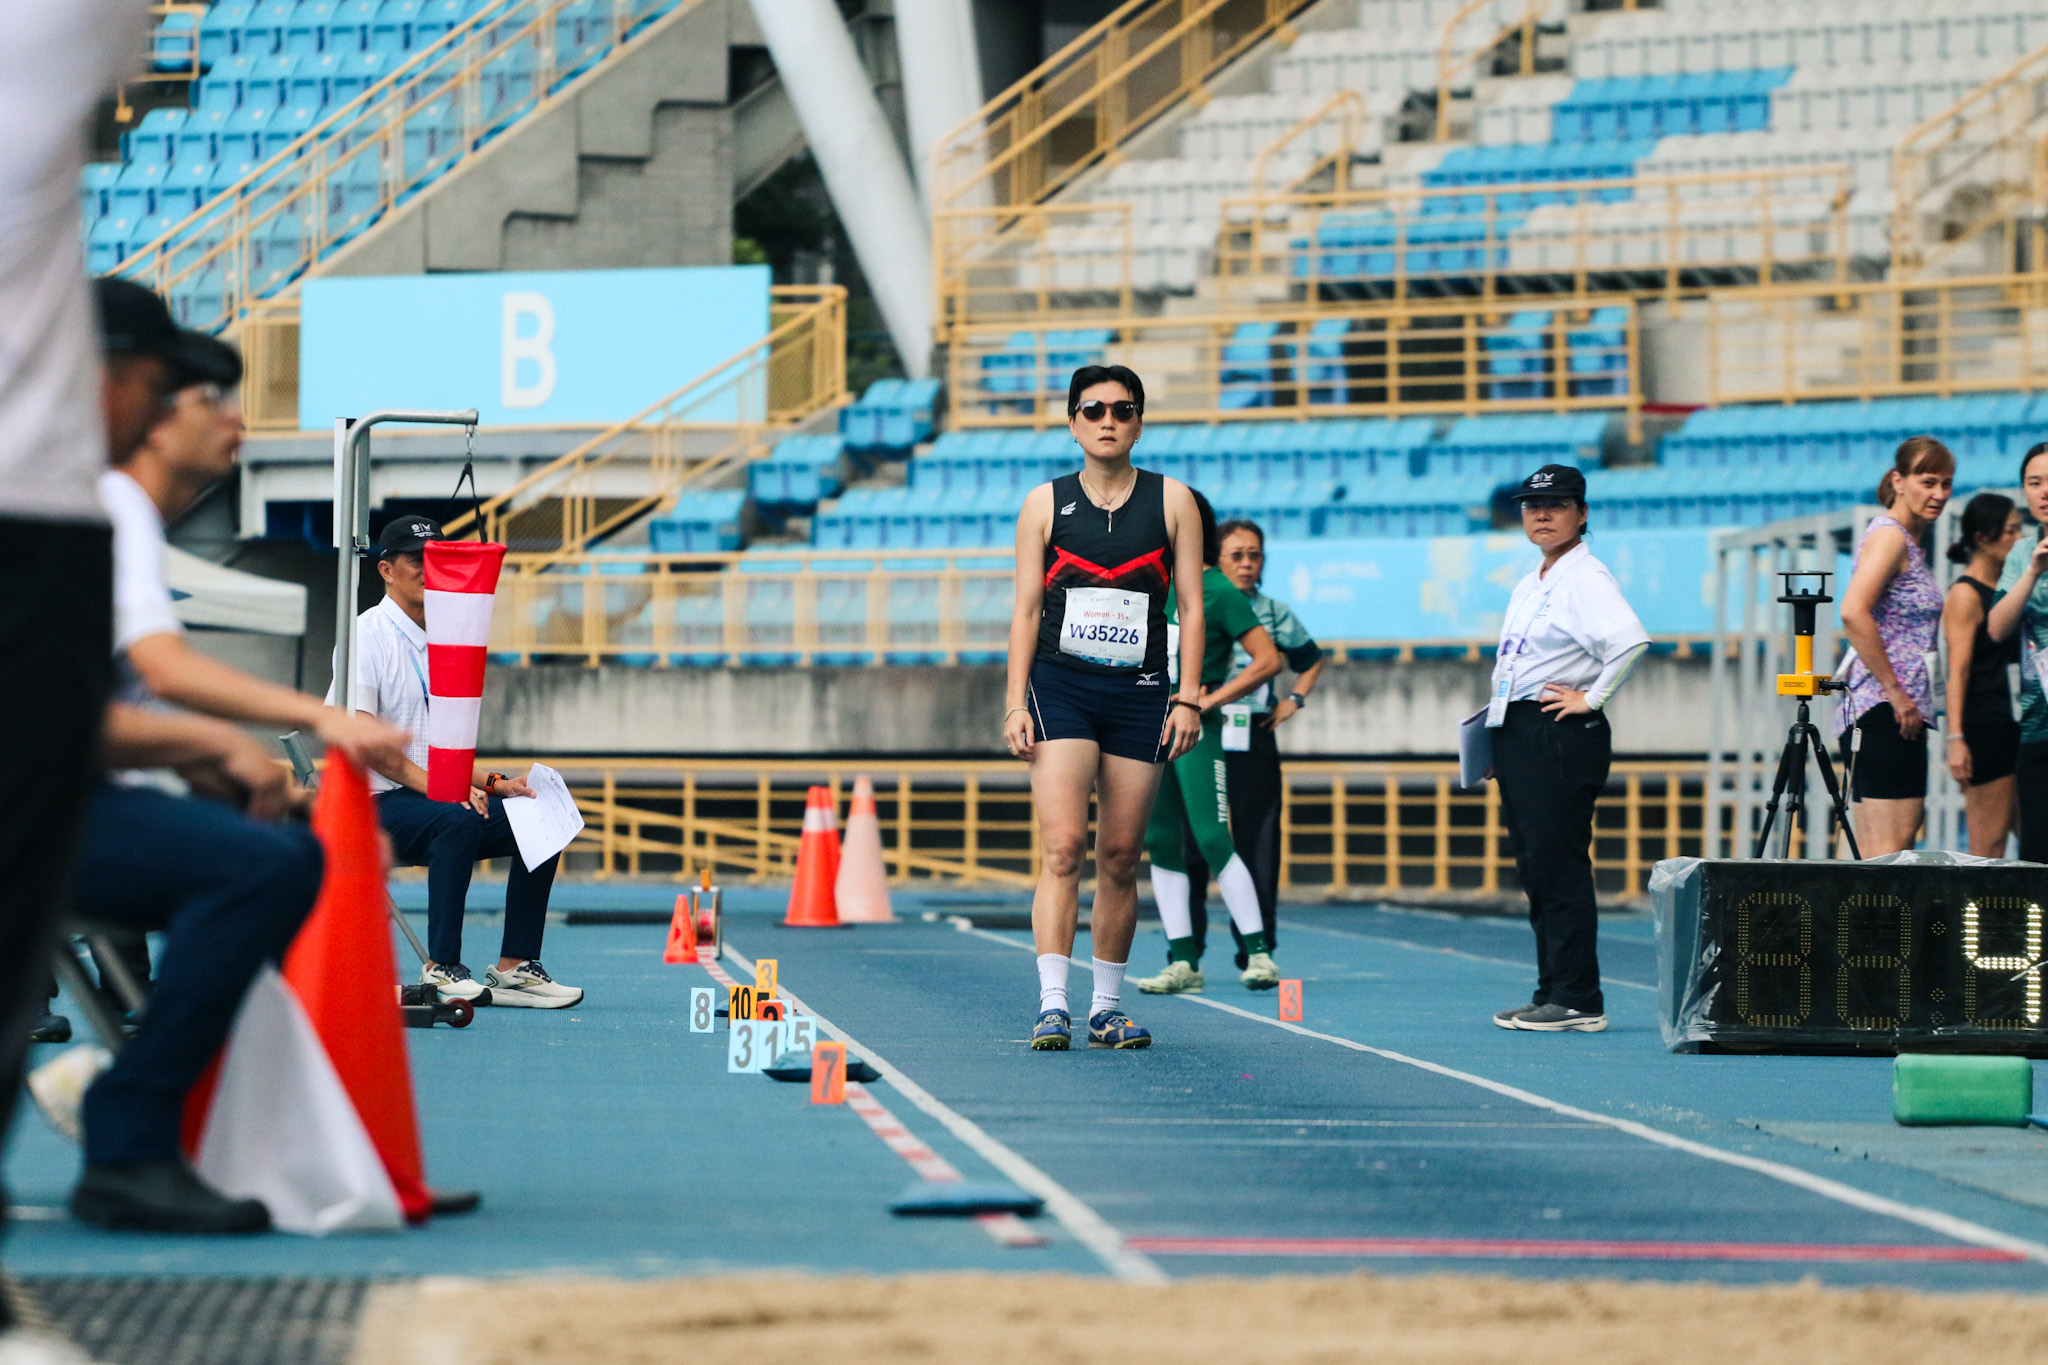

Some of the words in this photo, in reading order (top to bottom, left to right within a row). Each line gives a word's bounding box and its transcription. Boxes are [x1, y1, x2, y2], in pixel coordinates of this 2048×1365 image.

[502, 291, 557, 409] B
[1116, 612, 1130, 620] 35+
[1070, 623, 1139, 645] W35226
[1213, 759, 1227, 792] SAUDI
[1217, 792, 1229, 823] TEAM
[760, 962, 773, 989] 3
[695, 992, 710, 1030] 8
[732, 987, 751, 1020] 10
[1284, 983, 1298, 1018] 3
[734, 1024, 753, 1069] 3
[765, 1026, 778, 1069] 1
[794, 1021, 811, 1051] 5
[818, 1050, 839, 1099] 7
